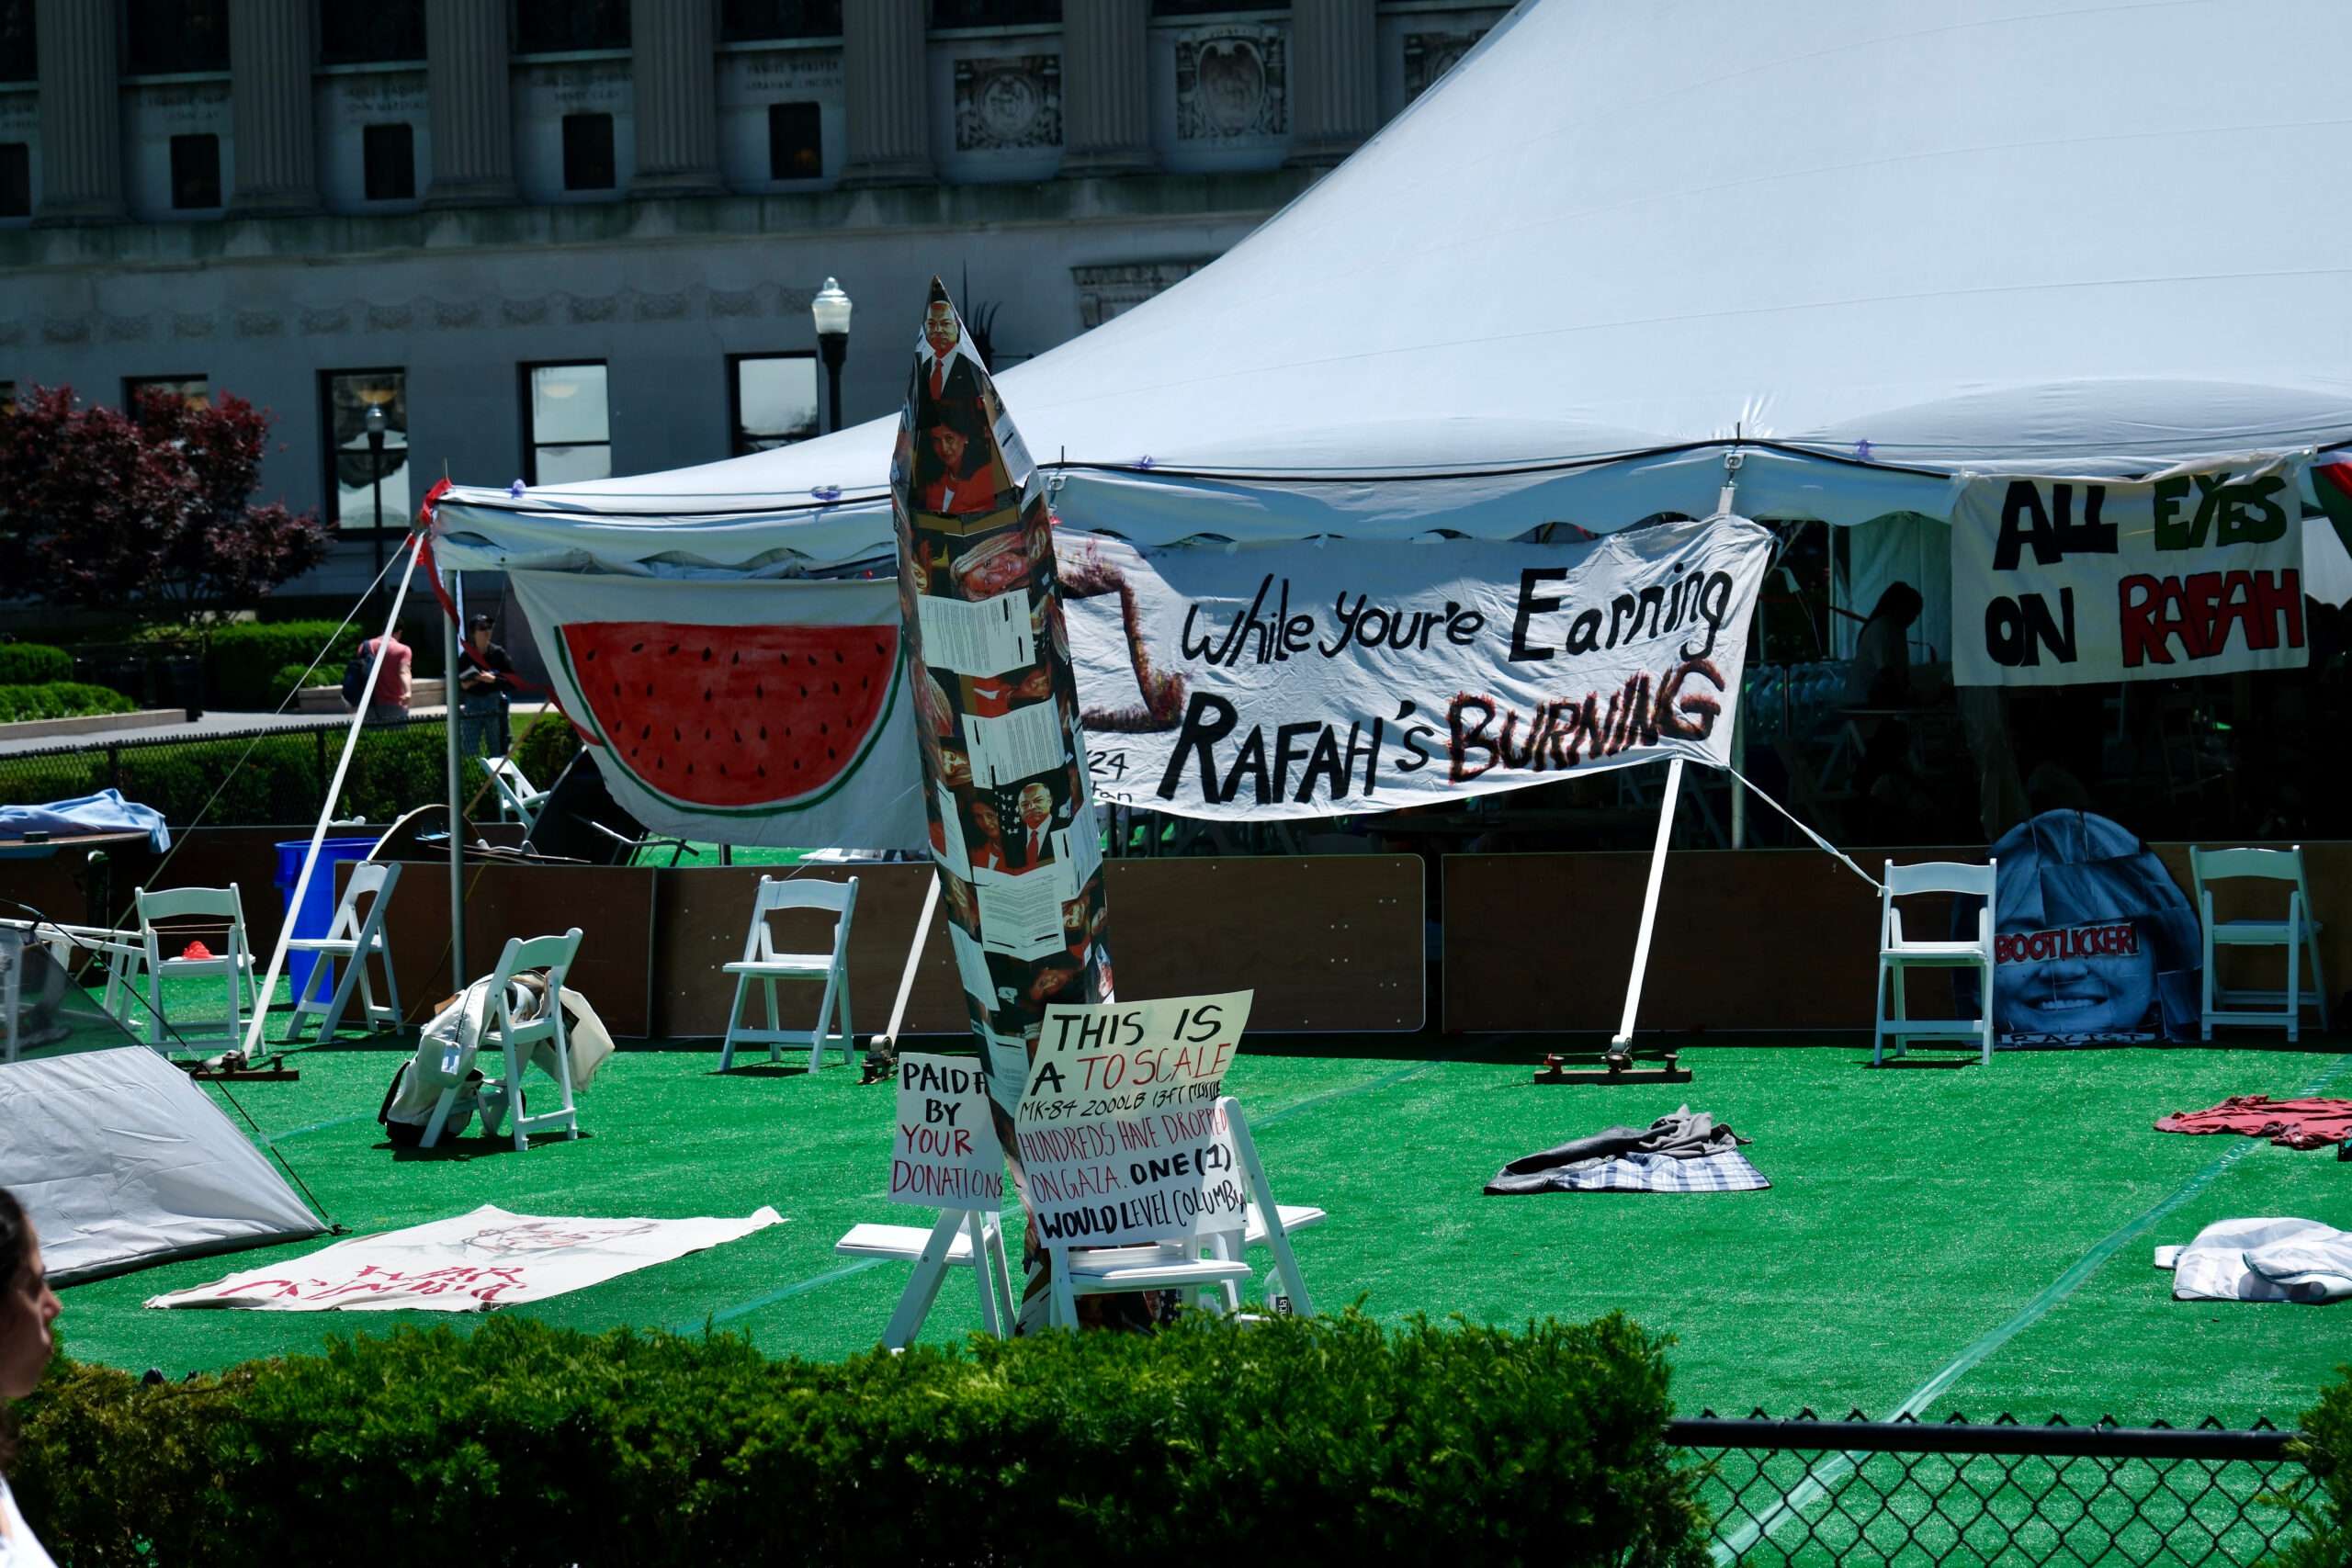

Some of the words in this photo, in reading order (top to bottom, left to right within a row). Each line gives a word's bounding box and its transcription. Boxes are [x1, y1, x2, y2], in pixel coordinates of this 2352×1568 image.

[1992, 479, 2119, 570] ALL
[2154, 471, 2288, 551] EYES
[1509, 561, 1734, 662] Earning
[1984, 586, 2078, 668] ON
[2119, 568, 2305, 668] RAFAH
[1444, 658, 1726, 786] BURNING
[1052, 1010, 1145, 1052] THIS
[1173, 1004, 1224, 1043] IS
[1030, 1061, 1067, 1097] A
[1077, 1054, 1125, 1091] TO
[1132, 1043, 1232, 1086] SCALE
[925, 1098, 962, 1127] BY
[1019, 1098, 1079, 1122] MK-84
[901, 1123, 975, 1157] YOUR
[1018, 1122, 1115, 1164] HUNDREDS
[1116, 1116, 1160, 1152] HAVE
[892, 1159, 1003, 1200] DONATIONS
[1031, 1170, 1063, 1204] ON
[1130, 1152, 1191, 1186] ONE
[1038, 1205, 1118, 1239] WOULD
[1119, 1190, 1172, 1230] LEVEL
